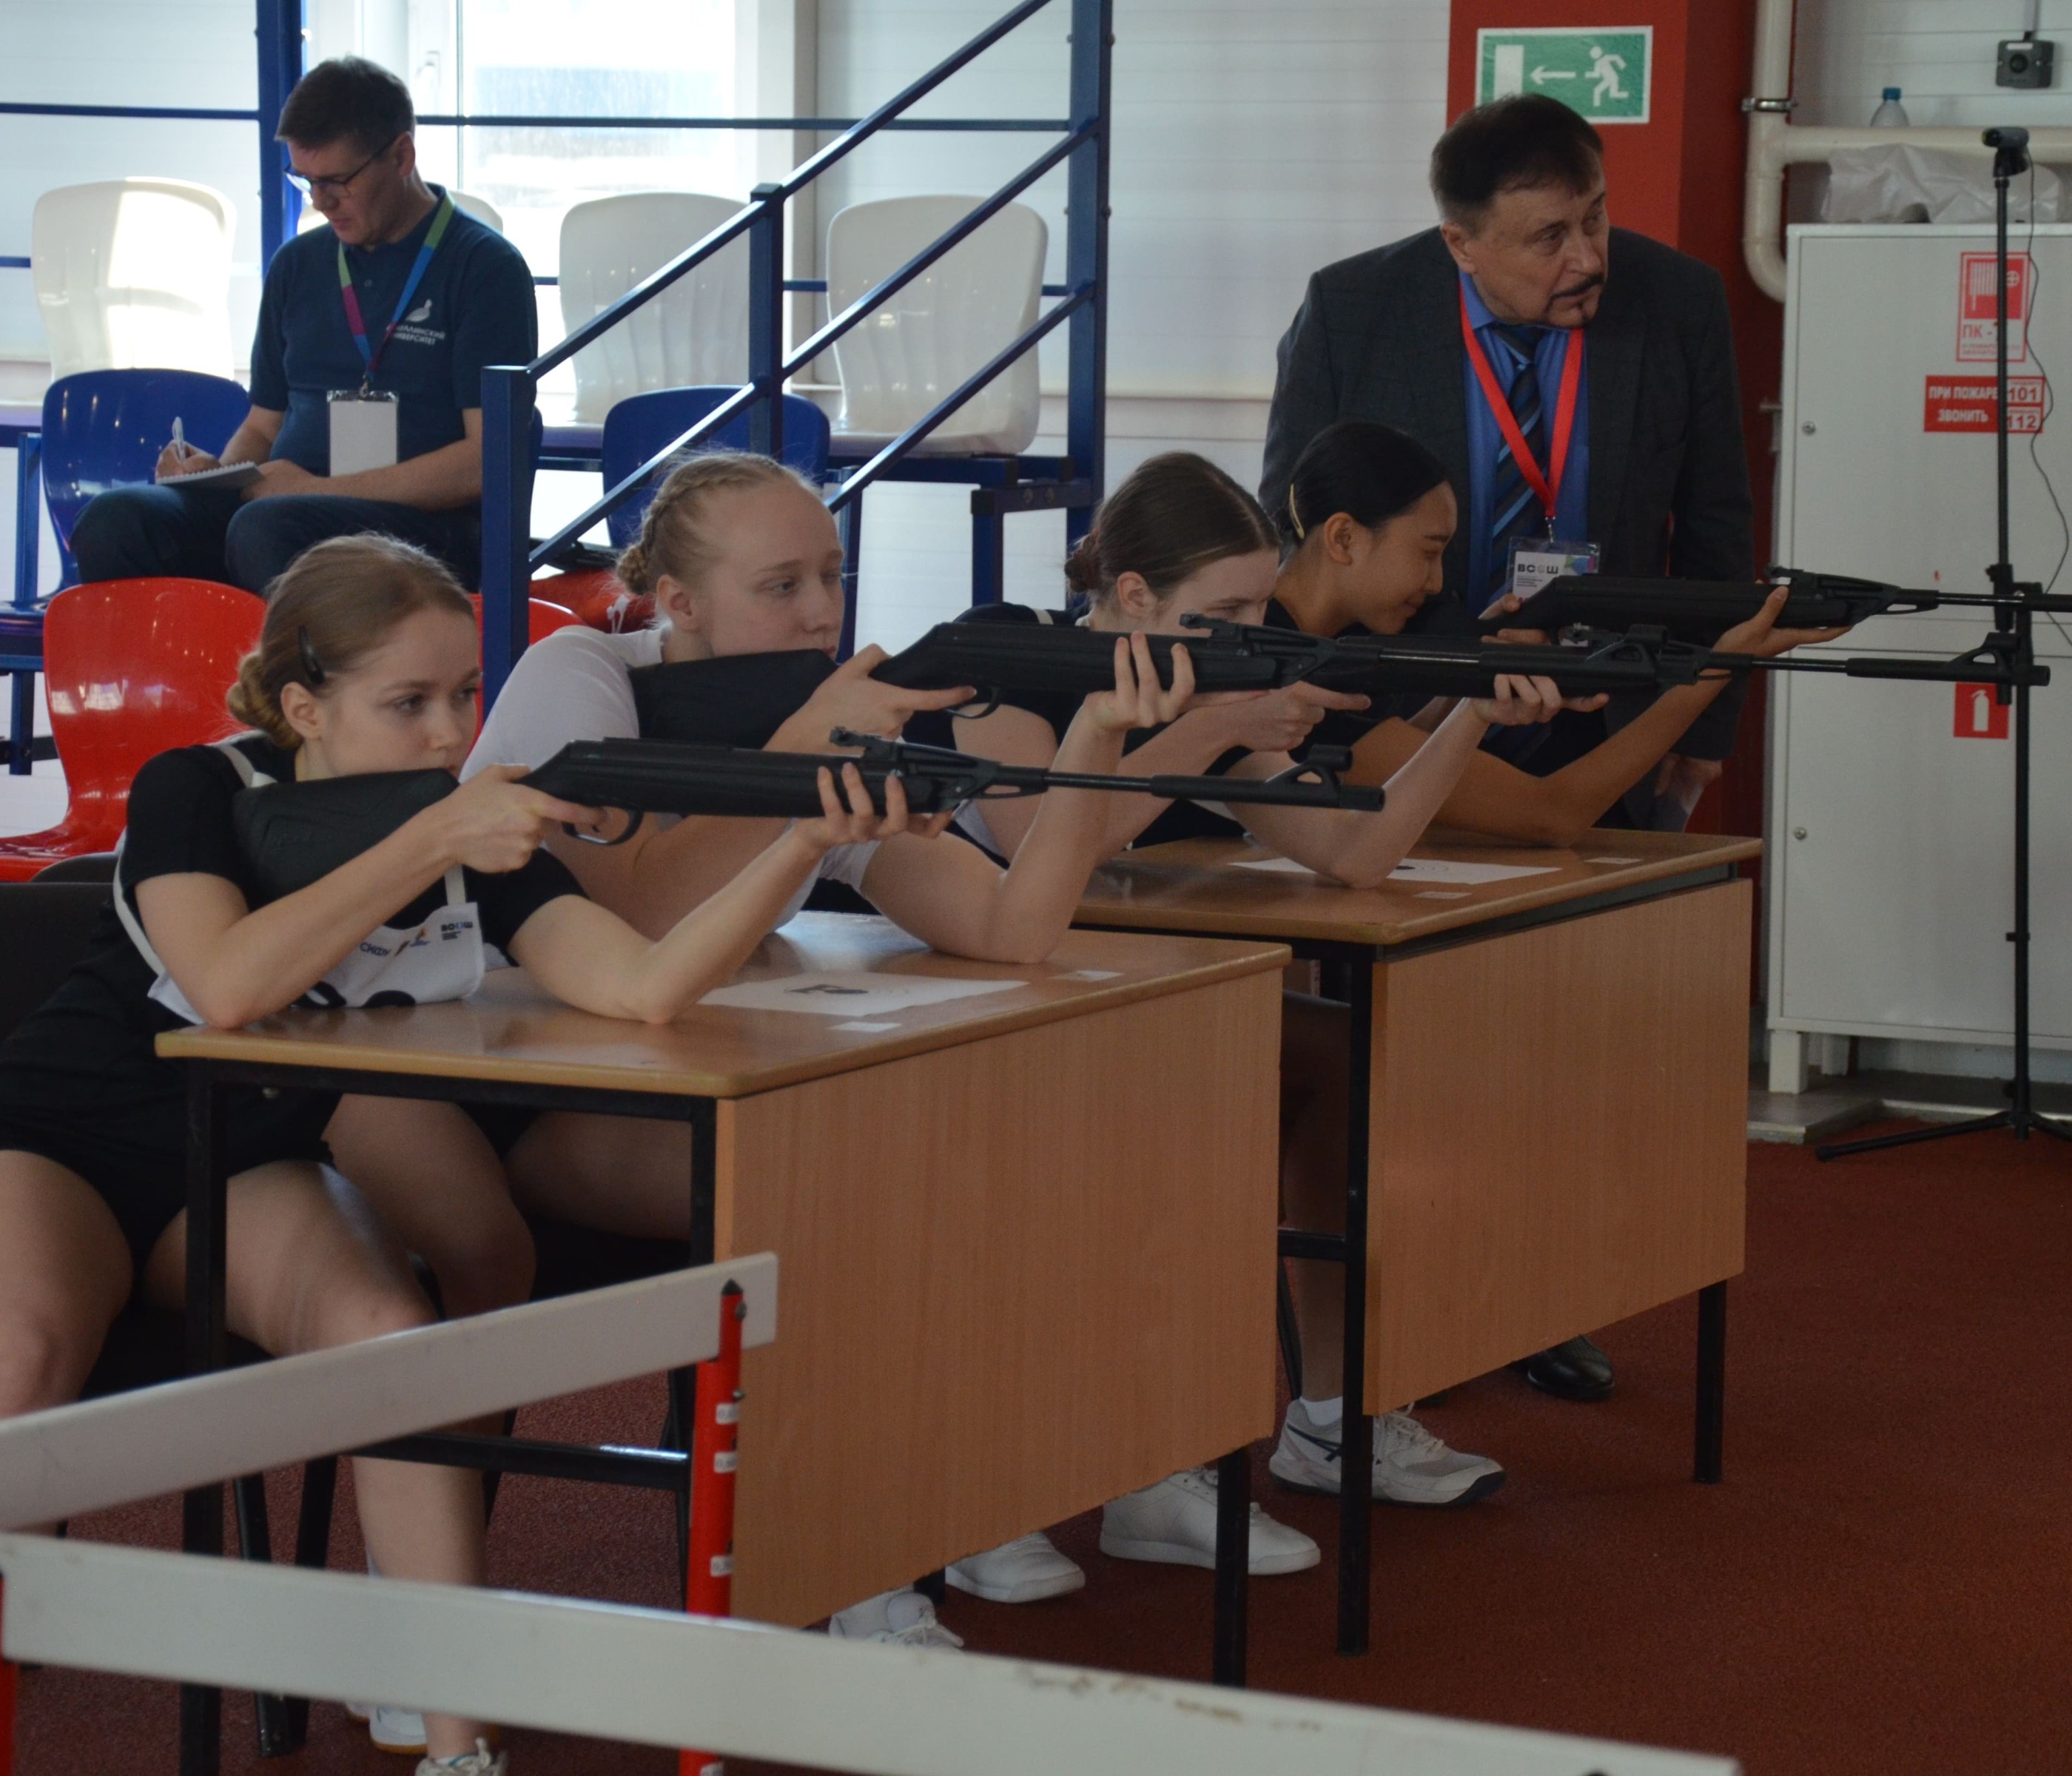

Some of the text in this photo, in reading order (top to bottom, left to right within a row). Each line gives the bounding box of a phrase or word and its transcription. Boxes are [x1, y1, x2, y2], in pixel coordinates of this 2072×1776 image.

[1962, 324, 1983, 338] ПК
[1929, 386, 1998, 400] ПРИ ПОЖАРЕ
[2008, 387, 2036, 400] 101
[1937, 408, 1988, 423] ЗВОНИТЬ
[2007, 415, 2036, 428] 112
